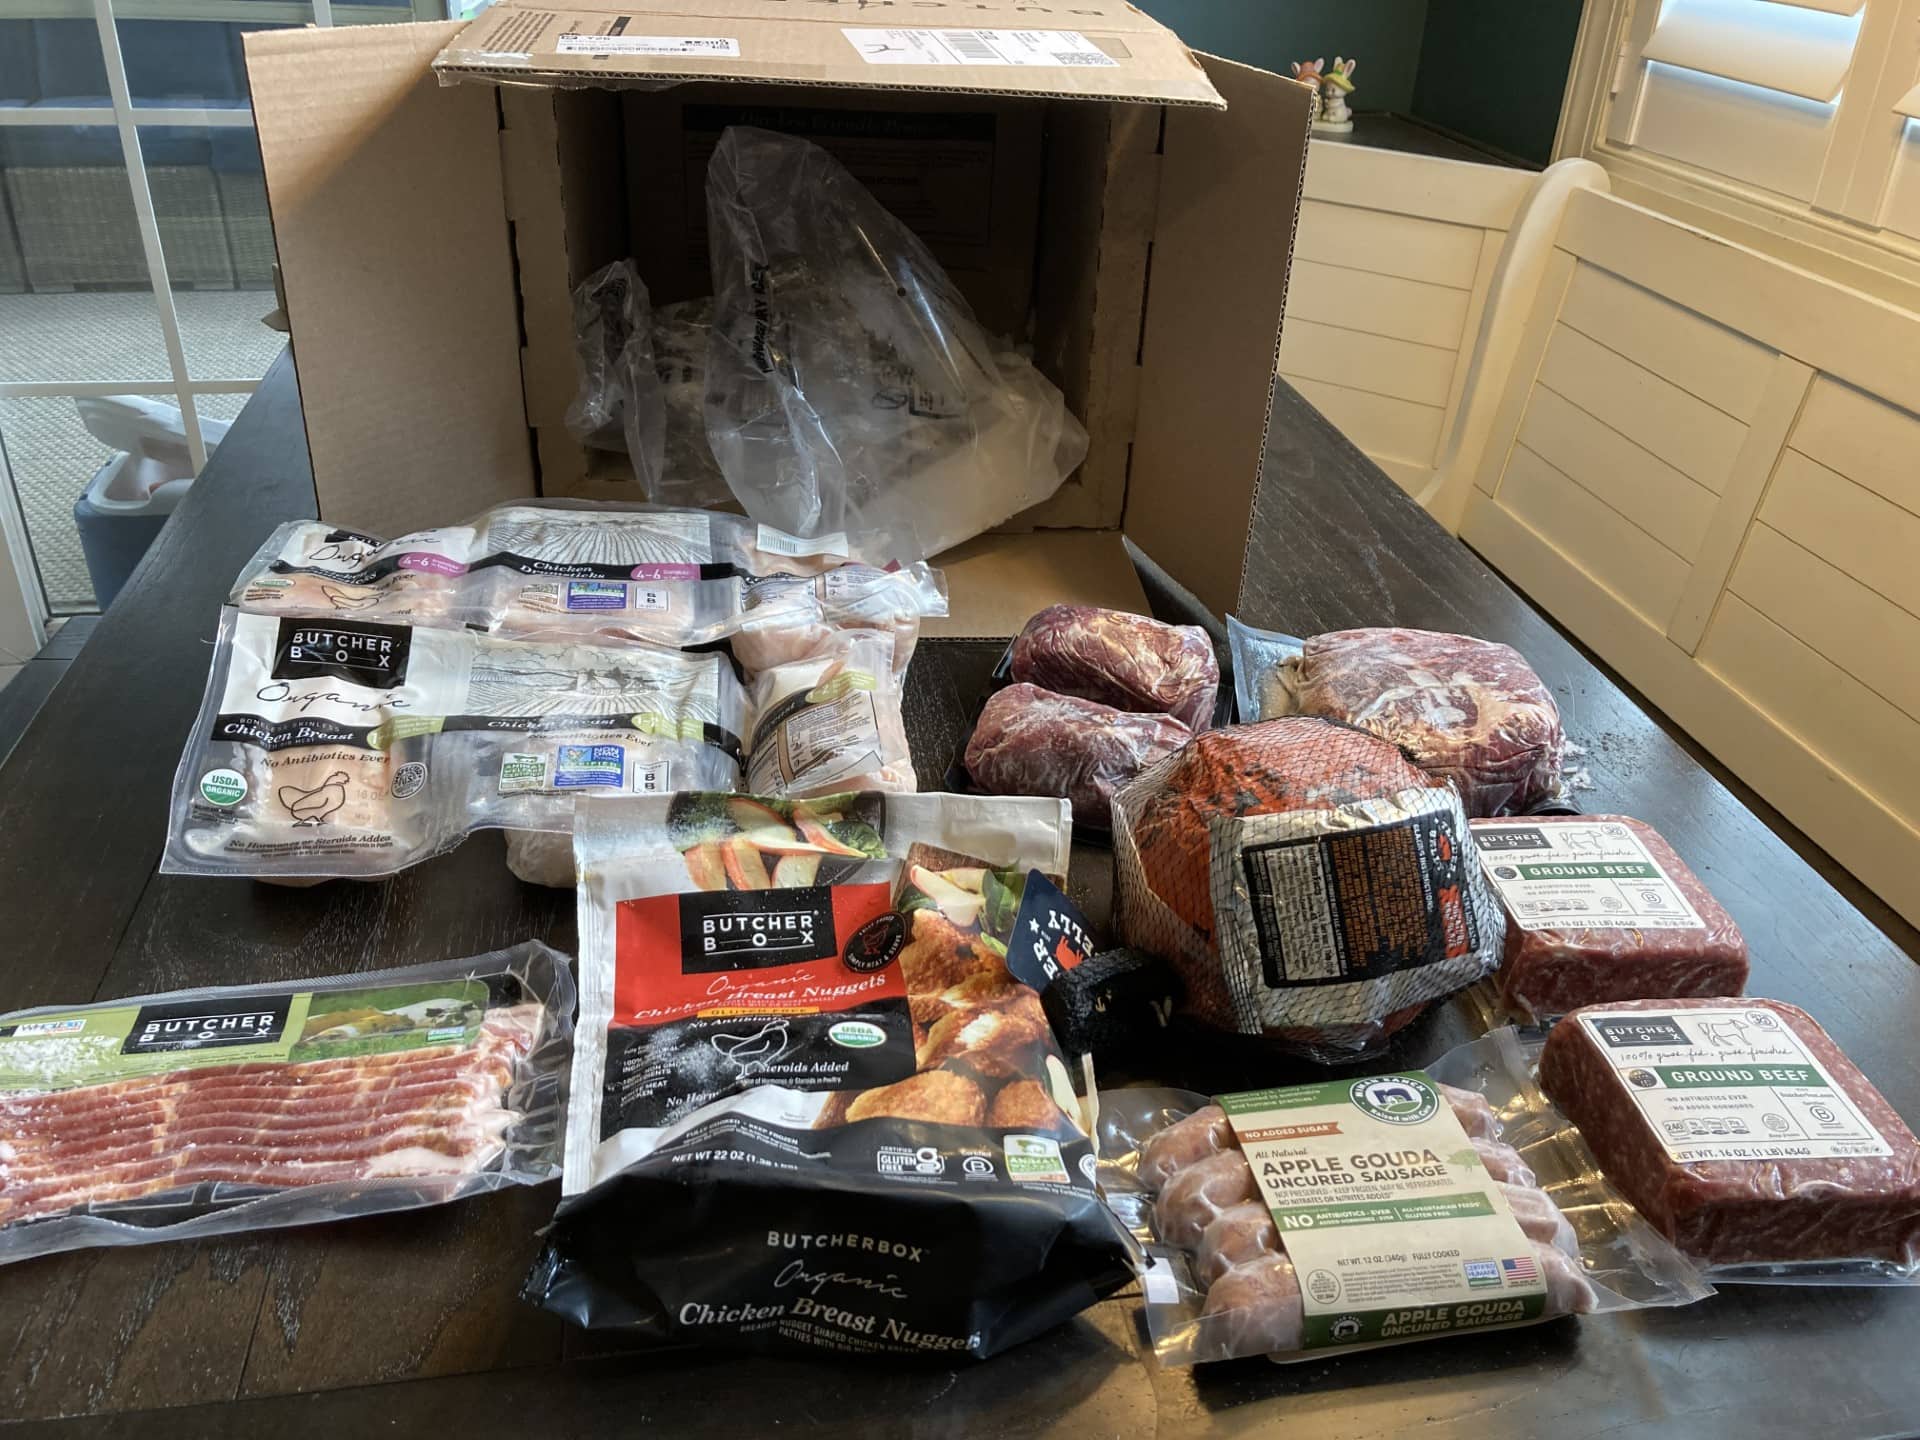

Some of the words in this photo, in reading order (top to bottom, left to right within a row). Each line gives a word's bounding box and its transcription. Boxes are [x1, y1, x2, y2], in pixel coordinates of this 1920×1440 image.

[533, 561, 592, 573] Chicken
[292, 632, 392, 653] BUTCHER
[257, 682, 411, 712] Organic
[223, 723, 292, 744] Chicken
[296, 727, 354, 741] Breast
[260, 758, 280, 768] No
[280, 751, 355, 766] Antibiotics
[359, 754, 390, 764] Ever
[212, 774, 240, 787] USDA
[206, 784, 241, 798] ORGANIC
[1480, 834, 1540, 842] BUTCHER
[1529, 864, 1599, 876] GROUND
[1603, 864, 1647, 875] BEEF
[703, 915, 814, 934] BUTCHER
[1048, 910, 1095, 957] ELLY
[706, 969, 815, 996] Organic
[634, 996, 721, 1019] Chicken
[802, 974, 886, 998] Nuggets
[145, 1014, 275, 1033] BUTCHER
[841, 1025, 874, 1034] USDA
[1606, 1026, 1675, 1035] BUTCHER
[811, 1061, 849, 1073] Added
[1671, 1071, 1754, 1083] GROUND
[1759, 1069, 1811, 1081] BEEF
[1383, 1077, 1427, 1093] RANCH
[1371, 1108, 1400, 1122] Raised
[1245, 1131, 1261, 1139] NO
[1263, 1128, 1296, 1138] ADDED
[1298, 1125, 1330, 1134] SUGAR
[672, 1152, 692, 1163] NET
[695, 1151, 712, 1161] WT
[713, 1151, 727, 1161] 22
[730, 1151, 745, 1161] OZ
[880, 1154, 916, 1166] GLUTEN
[1256, 1150, 1270, 1159] All
[1272, 1148, 1308, 1159] Natural
[1699, 1149, 1717, 1158] WT.
[1720, 1148, 1733, 1157] 16
[1262, 1156, 1344, 1176] APPLE
[1350, 1148, 1441, 1169] GOUDA
[1266, 1173, 1355, 1190] UNCURED
[1361, 1165, 1448, 1183] SAUSAGE
[1290, 1187, 1328, 1197] PRESERVED
[1334, 1186, 1350, 1195] KEEP
[1290, 1196, 1325, 1205] NITRATES
[1325, 1195, 1335, 1203] OR
[1336, 1193, 1366, 1202] NITRITES
[1283, 1214, 1314, 1229] NO
[1316, 1210, 1366, 1220] ANTIBIOTICS
[1370, 1208, 1392, 1216] EVER
[767, 1230, 922, 1262] BUTCHERBOX
[1337, 1258, 1350, 1267] NET
[1363, 1256, 1372, 1265] 12
[1413, 1252, 1431, 1261] FULLY
[1432, 1249, 1460, 1259] COOKED
[773, 1259, 908, 1298] Organic
[1468, 1269, 1497, 1278] HUMANE
[679, 1301, 785, 1326] Chicken
[792, 1297, 877, 1335] Breast
[1383, 1307, 1449, 1326] APPLE
[1456, 1300, 1525, 1318] GOUDA
[1381, 1321, 1450, 1337] UNCURED
[1455, 1313, 1524, 1327] SAUSAGE
[778, 1327, 811, 1344] PATTIES
[813, 1336, 835, 1349] WITH
[779, 1318, 812, 1332] NUGGET
[814, 1325, 846, 1342] SHAPED
[848, 1336, 885, 1351] CHICKEN
